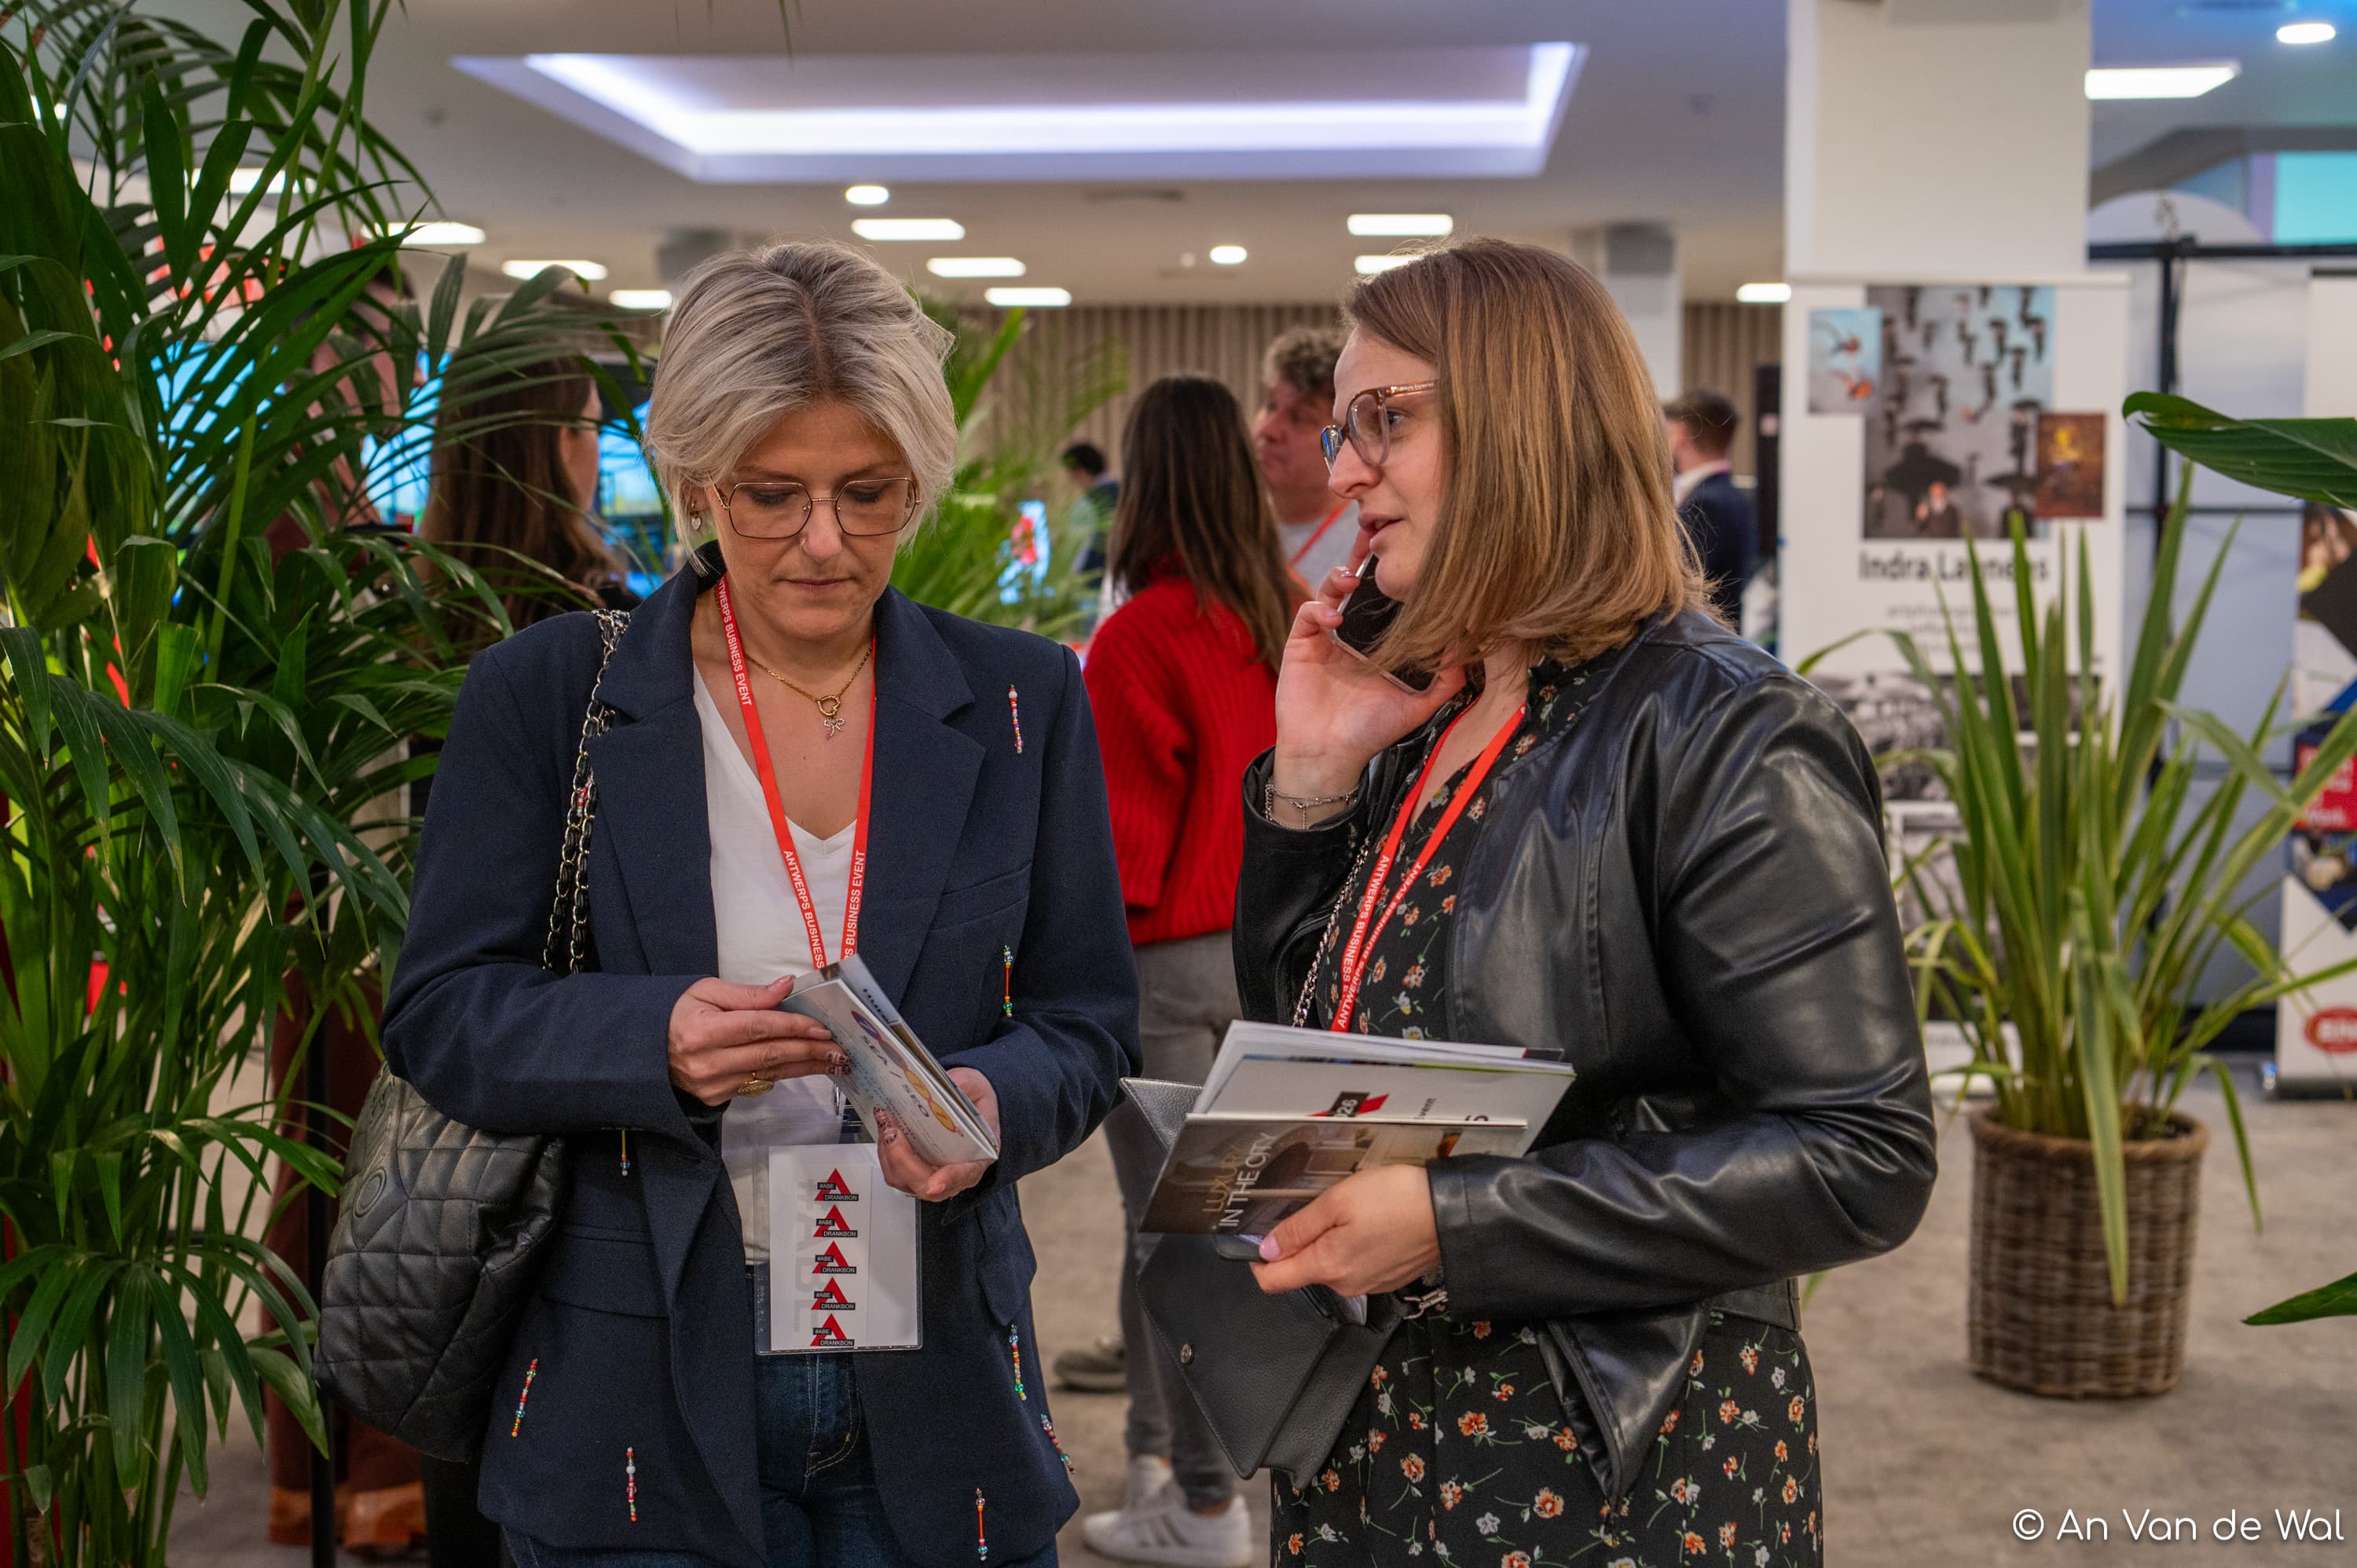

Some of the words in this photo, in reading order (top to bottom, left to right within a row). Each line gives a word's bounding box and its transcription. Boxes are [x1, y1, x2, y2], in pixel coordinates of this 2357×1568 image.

[1859, 549, 1930, 581] Indra
[718, 577, 732, 623] NTWERPS
[725, 623, 743, 672] BUSINESS
[735, 672, 752, 705] EVENT
[852, 849, 865, 887] EVENT
[1360, 855, 1390, 918] ANTWERPS
[784, 850, 810, 910] ANTWERPS
[805, 912, 825, 969] BUSINESS
[845, 888, 861, 946] BUSINESS
[1337, 961, 1365, 1028] ANTWERPS
[1362, 902, 1397, 959] BUSINESS
[1395, 862, 1421, 899] EVENT
[1343, 921, 1365, 982] BUSINESS
[861, 1036, 888, 1066] SEA
[901, 1084, 929, 1118] SEO
[1244, 1132, 1277, 1168] CITY
[1219, 1209, 1244, 1226] IN
[1226, 1171, 1261, 1207] THE
